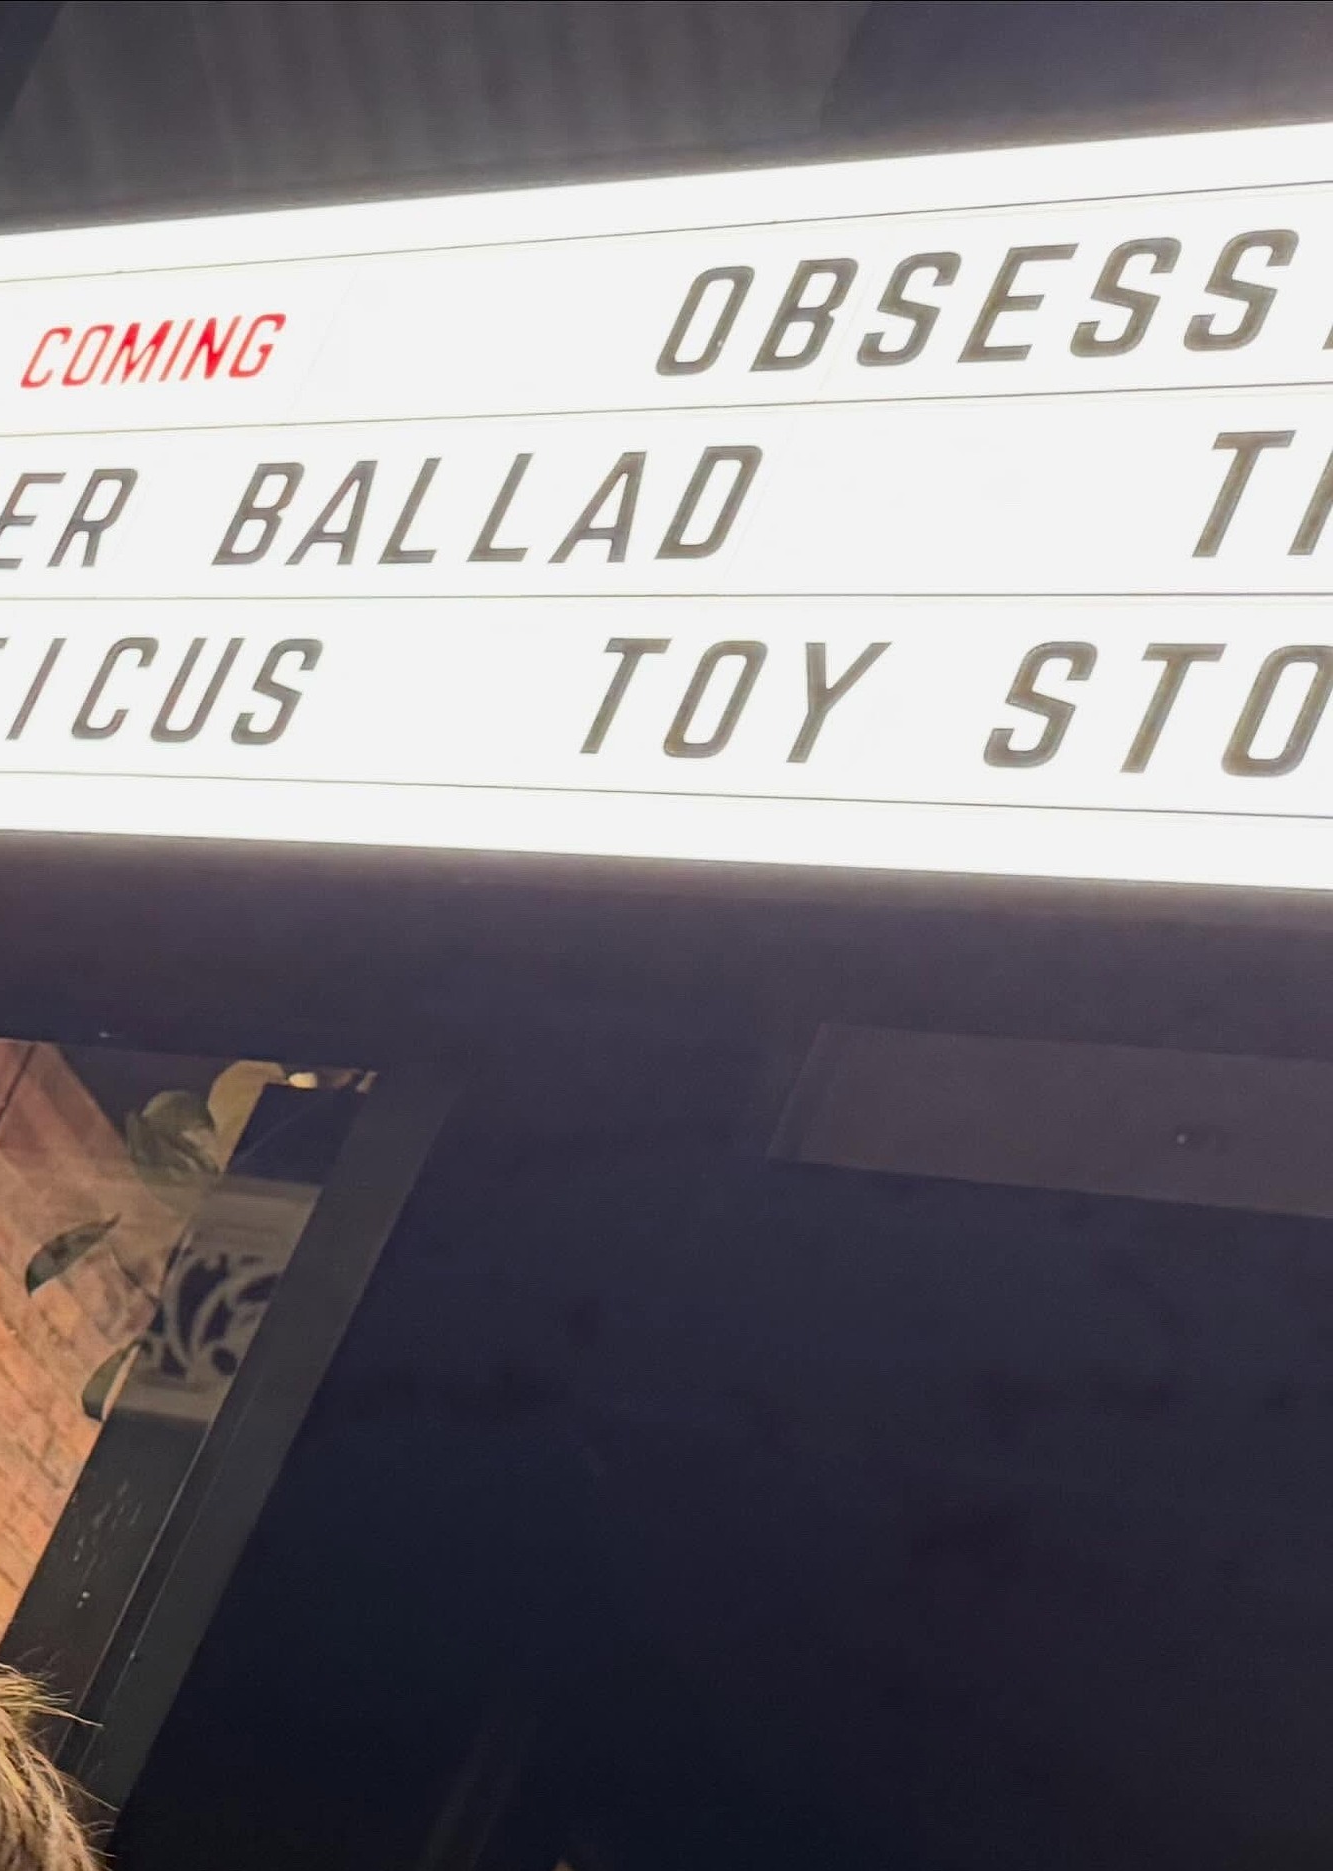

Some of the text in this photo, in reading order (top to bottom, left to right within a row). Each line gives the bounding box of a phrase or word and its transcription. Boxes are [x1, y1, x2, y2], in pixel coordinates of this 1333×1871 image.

[19, 312, 287, 390] COMING
[655, 228, 1333, 377] OBSESS
[210, 444, 764, 566] BALLAD
[579, 637, 892, 764] TOY
